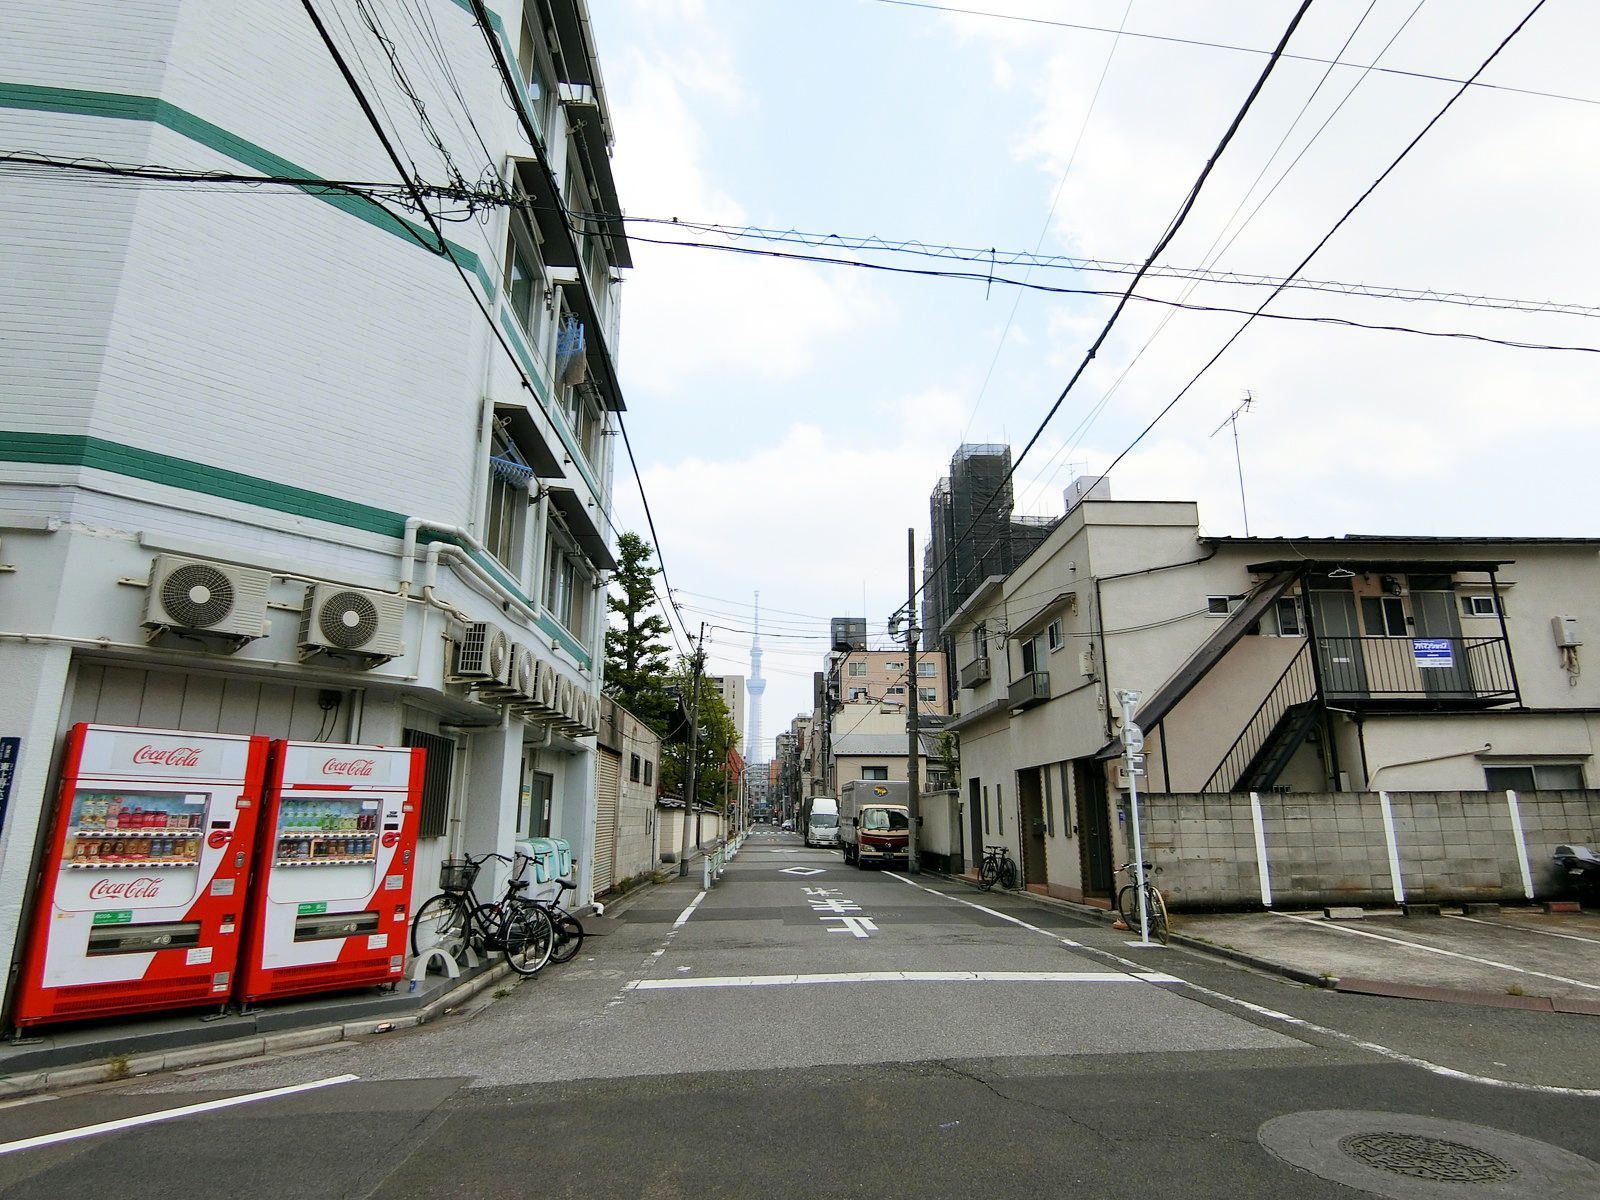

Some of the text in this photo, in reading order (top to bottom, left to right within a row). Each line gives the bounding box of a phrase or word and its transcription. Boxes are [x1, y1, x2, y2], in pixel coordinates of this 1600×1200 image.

[132, 744, 206, 767] Coca-Cola
[322, 757, 376, 776] Coca-Cola
[89, 878, 164, 900] Coca-Cola
